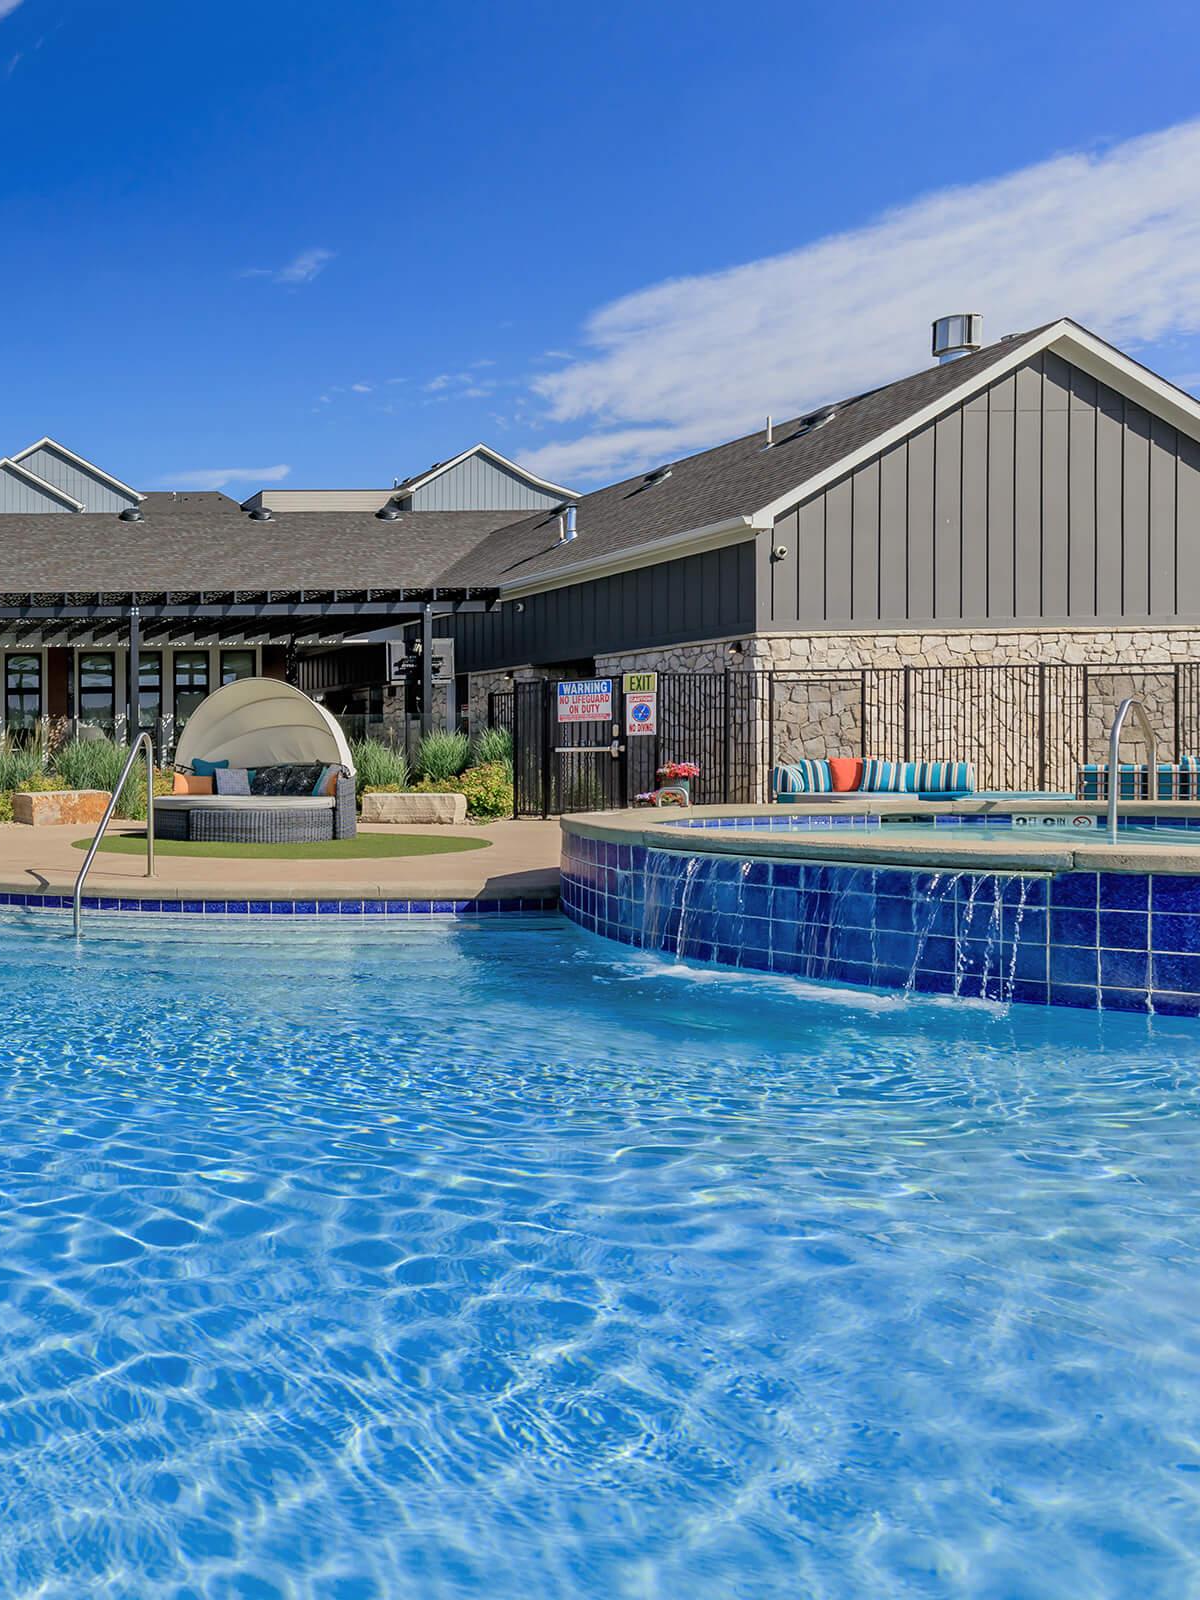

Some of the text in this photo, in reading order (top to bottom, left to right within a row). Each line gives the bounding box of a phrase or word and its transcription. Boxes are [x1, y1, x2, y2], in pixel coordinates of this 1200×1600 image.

[562, 681, 608, 695] WARNING
[630, 675, 652, 691] EXIT
[560, 693, 609, 704] NO LIFEGUARD
[569, 703, 600, 713] ON DUTY
